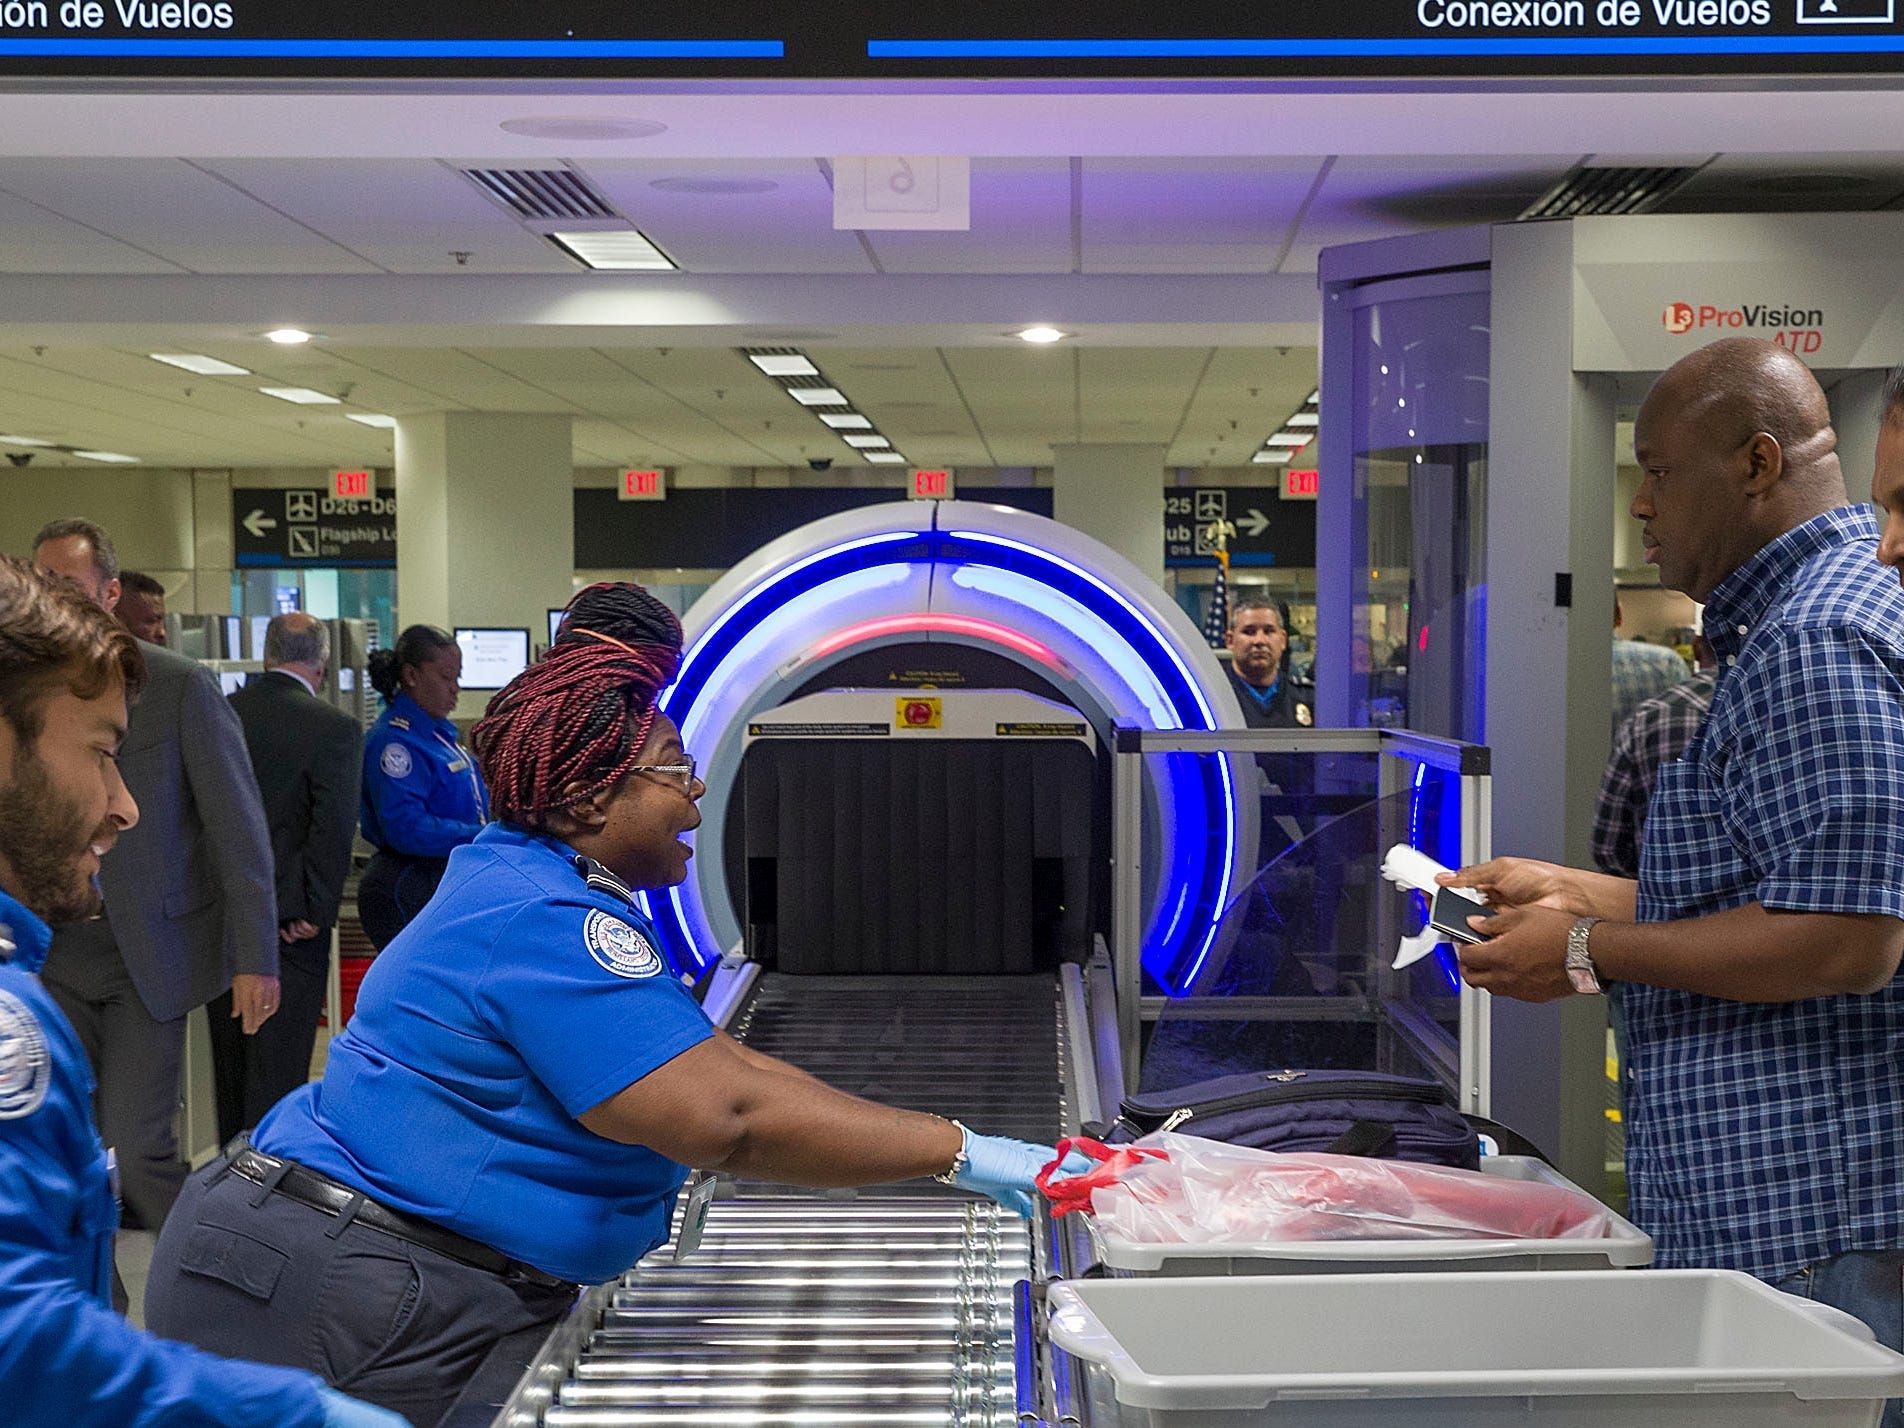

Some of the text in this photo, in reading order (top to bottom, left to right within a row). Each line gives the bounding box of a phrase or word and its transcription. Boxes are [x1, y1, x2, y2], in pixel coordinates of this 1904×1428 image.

[60, 0, 104, 28] de
[115, 0, 234, 28] Vuelos
[1417, 0, 1771, 27] Conexión de Vuelos
[1664, 304, 1823, 333] L3 ProVision
[1774, 330, 1822, 353] ATD
[336, 471, 368, 496] EXIT
[626, 470, 658, 496] EXIT
[916, 470, 947, 496] EXIT
[1165, 498, 1192, 514] 25
[321, 527, 380, 543] Flagship
